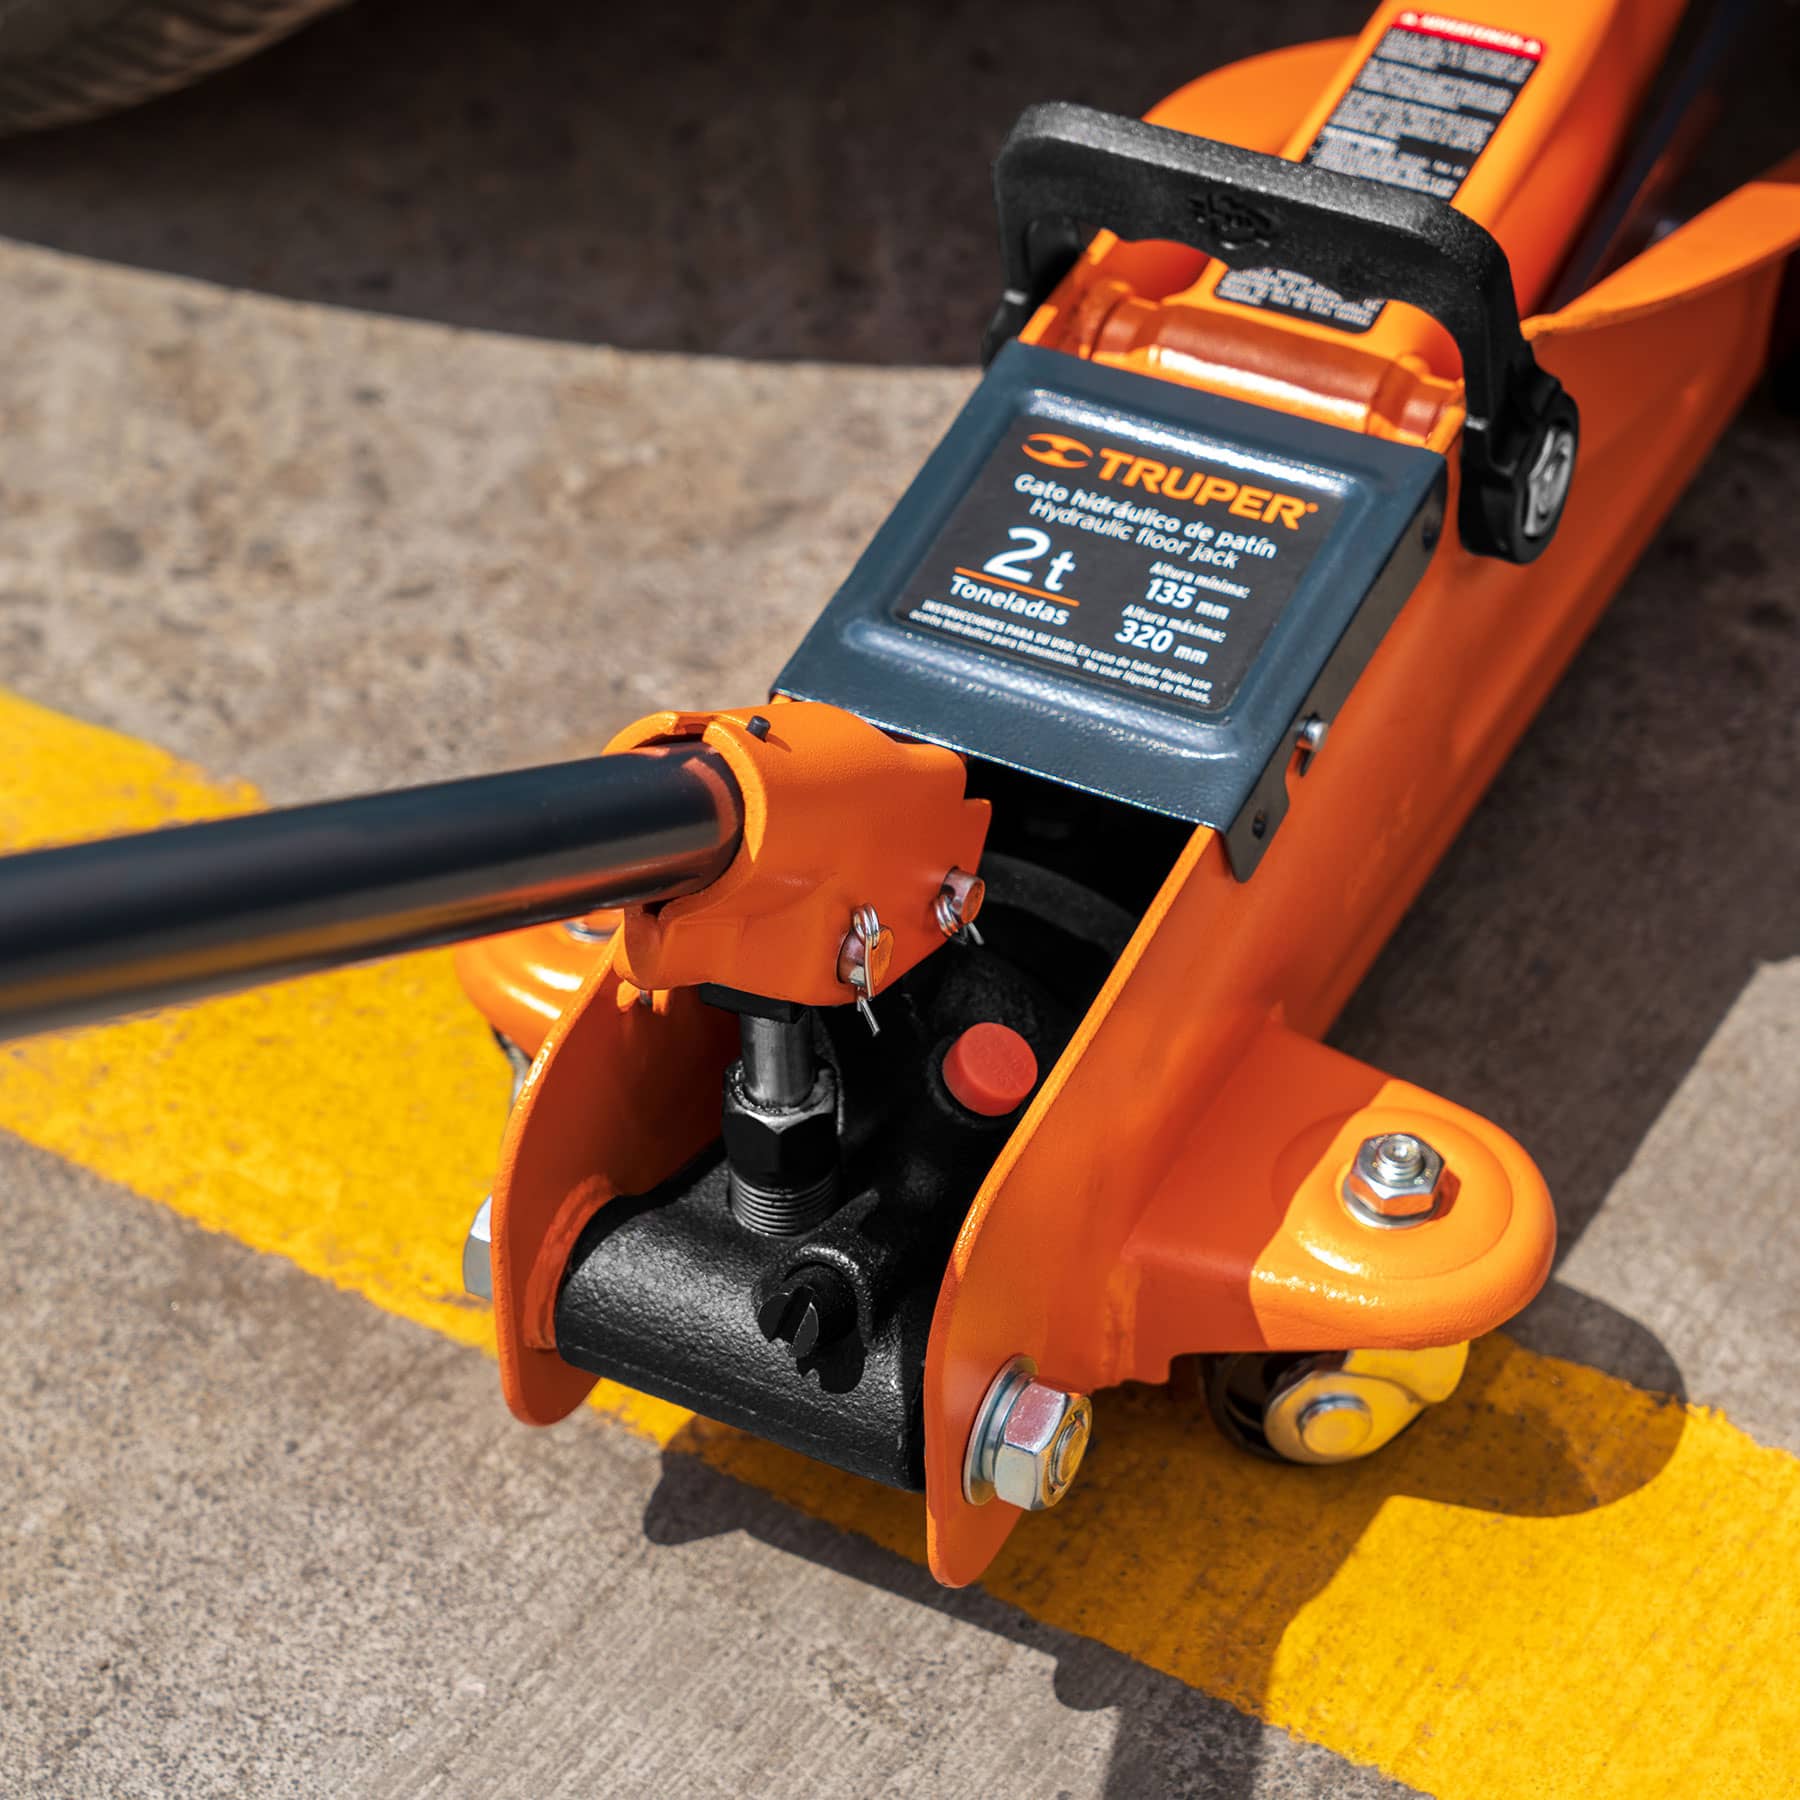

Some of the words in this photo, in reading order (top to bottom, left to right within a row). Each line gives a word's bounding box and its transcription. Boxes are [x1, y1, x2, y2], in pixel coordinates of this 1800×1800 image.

[1098, 448, 1315, 530] TRUPER
[1015, 475, 1068, 501] Gato
[1071, 489, 1180, 532] hidráulico
[1184, 522, 1214, 541] de
[1215, 532, 1276, 558] patín
[1030, 499, 1134, 540] Hydraulic
[1136, 527, 1191, 554] floor
[1188, 542, 1239, 569] jack
[983, 528, 1050, 582] 2
[1045, 552, 1075, 591] t
[1150, 562, 1194, 583] Altura
[951, 576, 1069, 625] Toneladas
[1122, 605, 1167, 626] Altura
[1146, 578, 1196, 608] 135
[1196, 601, 1229, 620] mm
[1115, 620, 1173, 652] 320
[1174, 645, 1208, 664] mm
